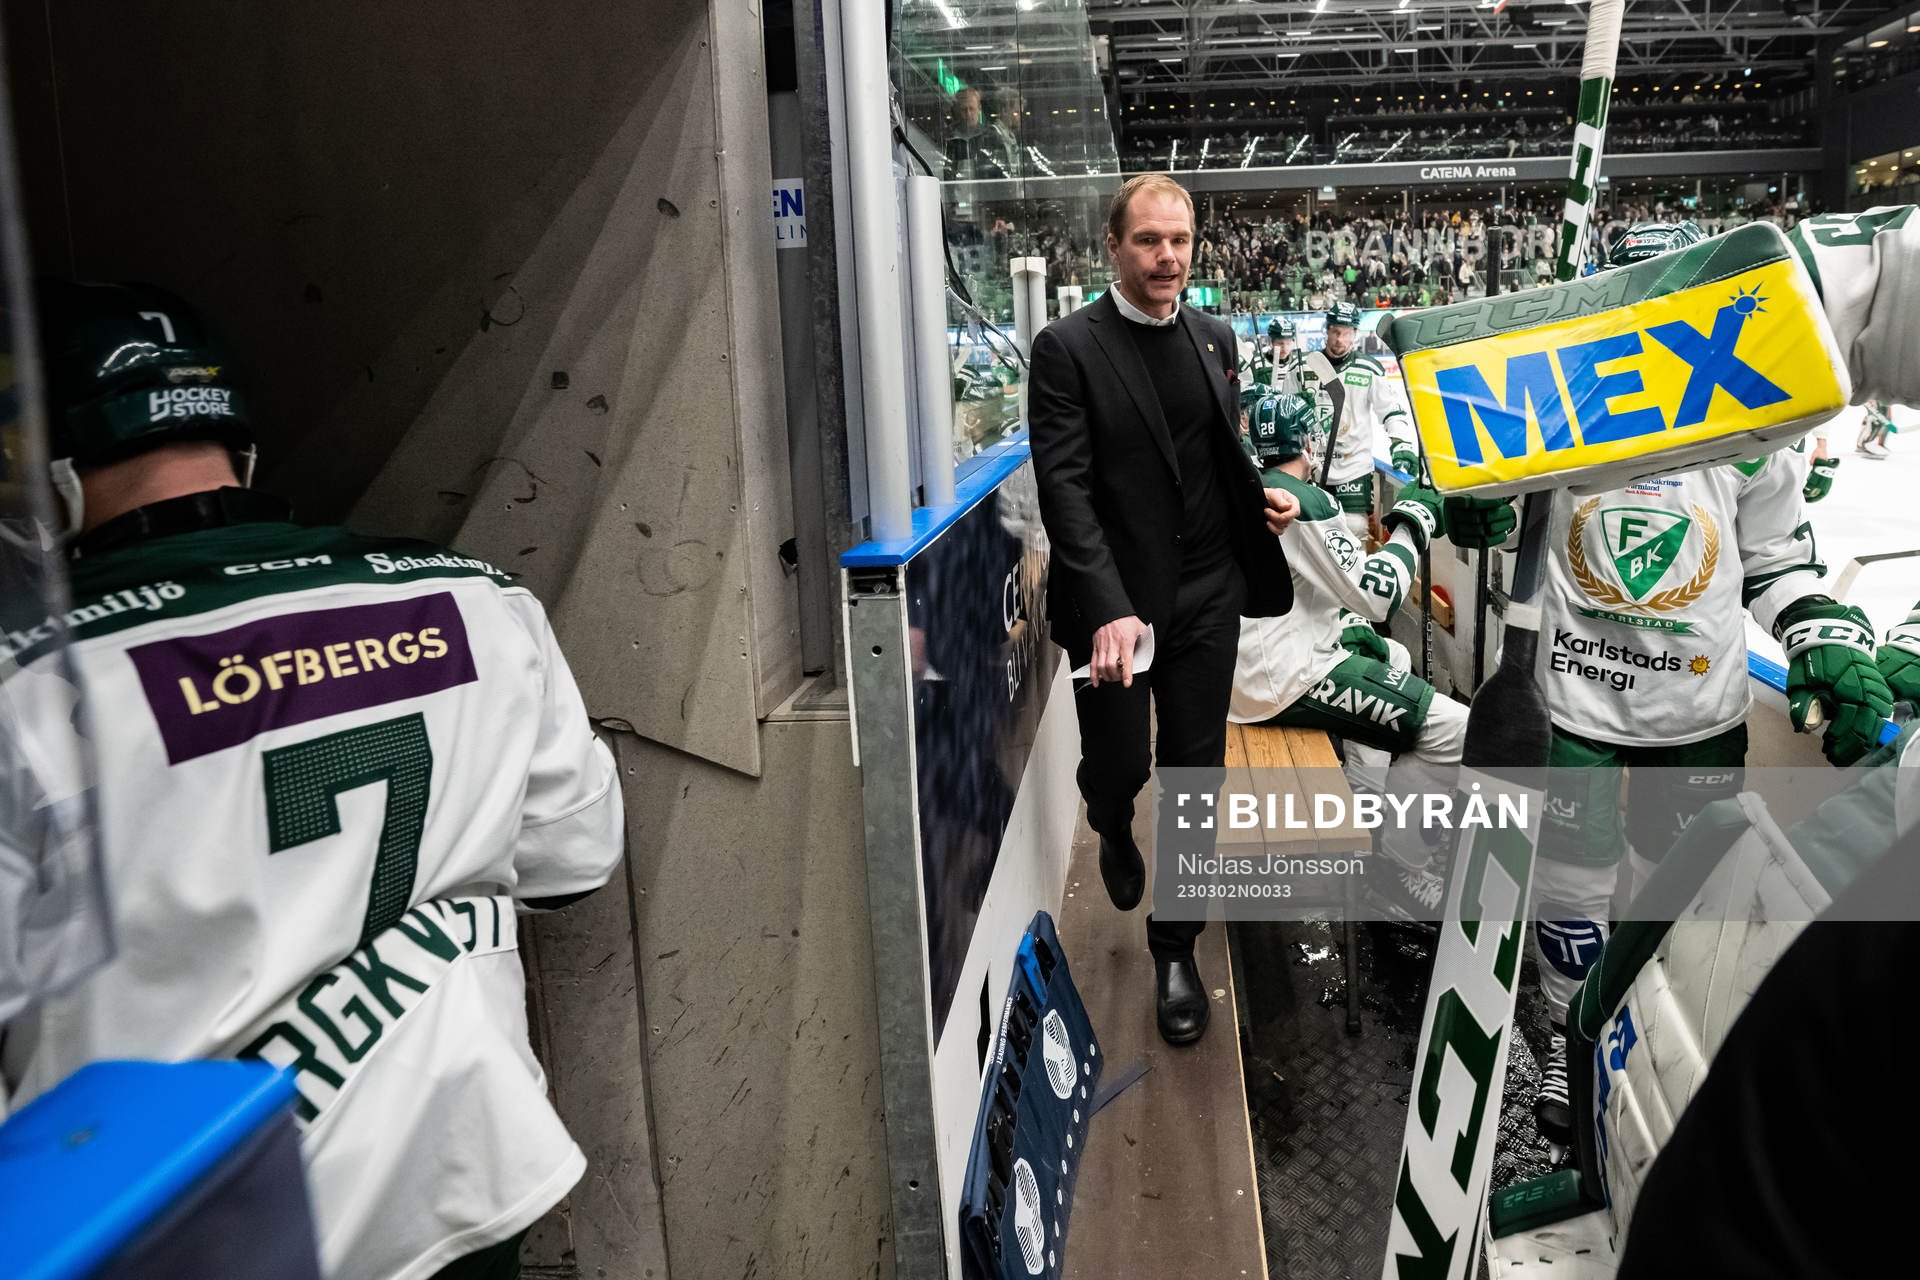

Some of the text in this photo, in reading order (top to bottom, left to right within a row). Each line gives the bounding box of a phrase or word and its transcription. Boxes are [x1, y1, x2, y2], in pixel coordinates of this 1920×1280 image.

[1421, 166, 1516, 179] CATENA Arena
[138, 311, 176, 342] 7
[1415, 270, 1632, 346] CCM
[1435, 302, 1792, 468] MEX
[149, 388, 230, 421] HOCKEY
[172, 401, 235, 417] STORE
[1261, 422, 1275, 435] 28
[1618, 516, 1650, 553] F
[224, 554, 332, 575] CCM
[1358, 558, 1397, 600] 28
[1630, 540, 1663, 581] BK
[1597, 610, 1674, 628] KARLSTAD
[1553, 628, 1682, 672] Karlstads
[1785, 625, 1875, 652] CCM
[179, 626, 450, 716] LÖFBERGS
[1550, 651, 1635, 692] Energi
[1309, 678, 1408, 733] RAVIK
[1688, 772, 1735, 784] CCM
[262, 711, 433, 949] 7
